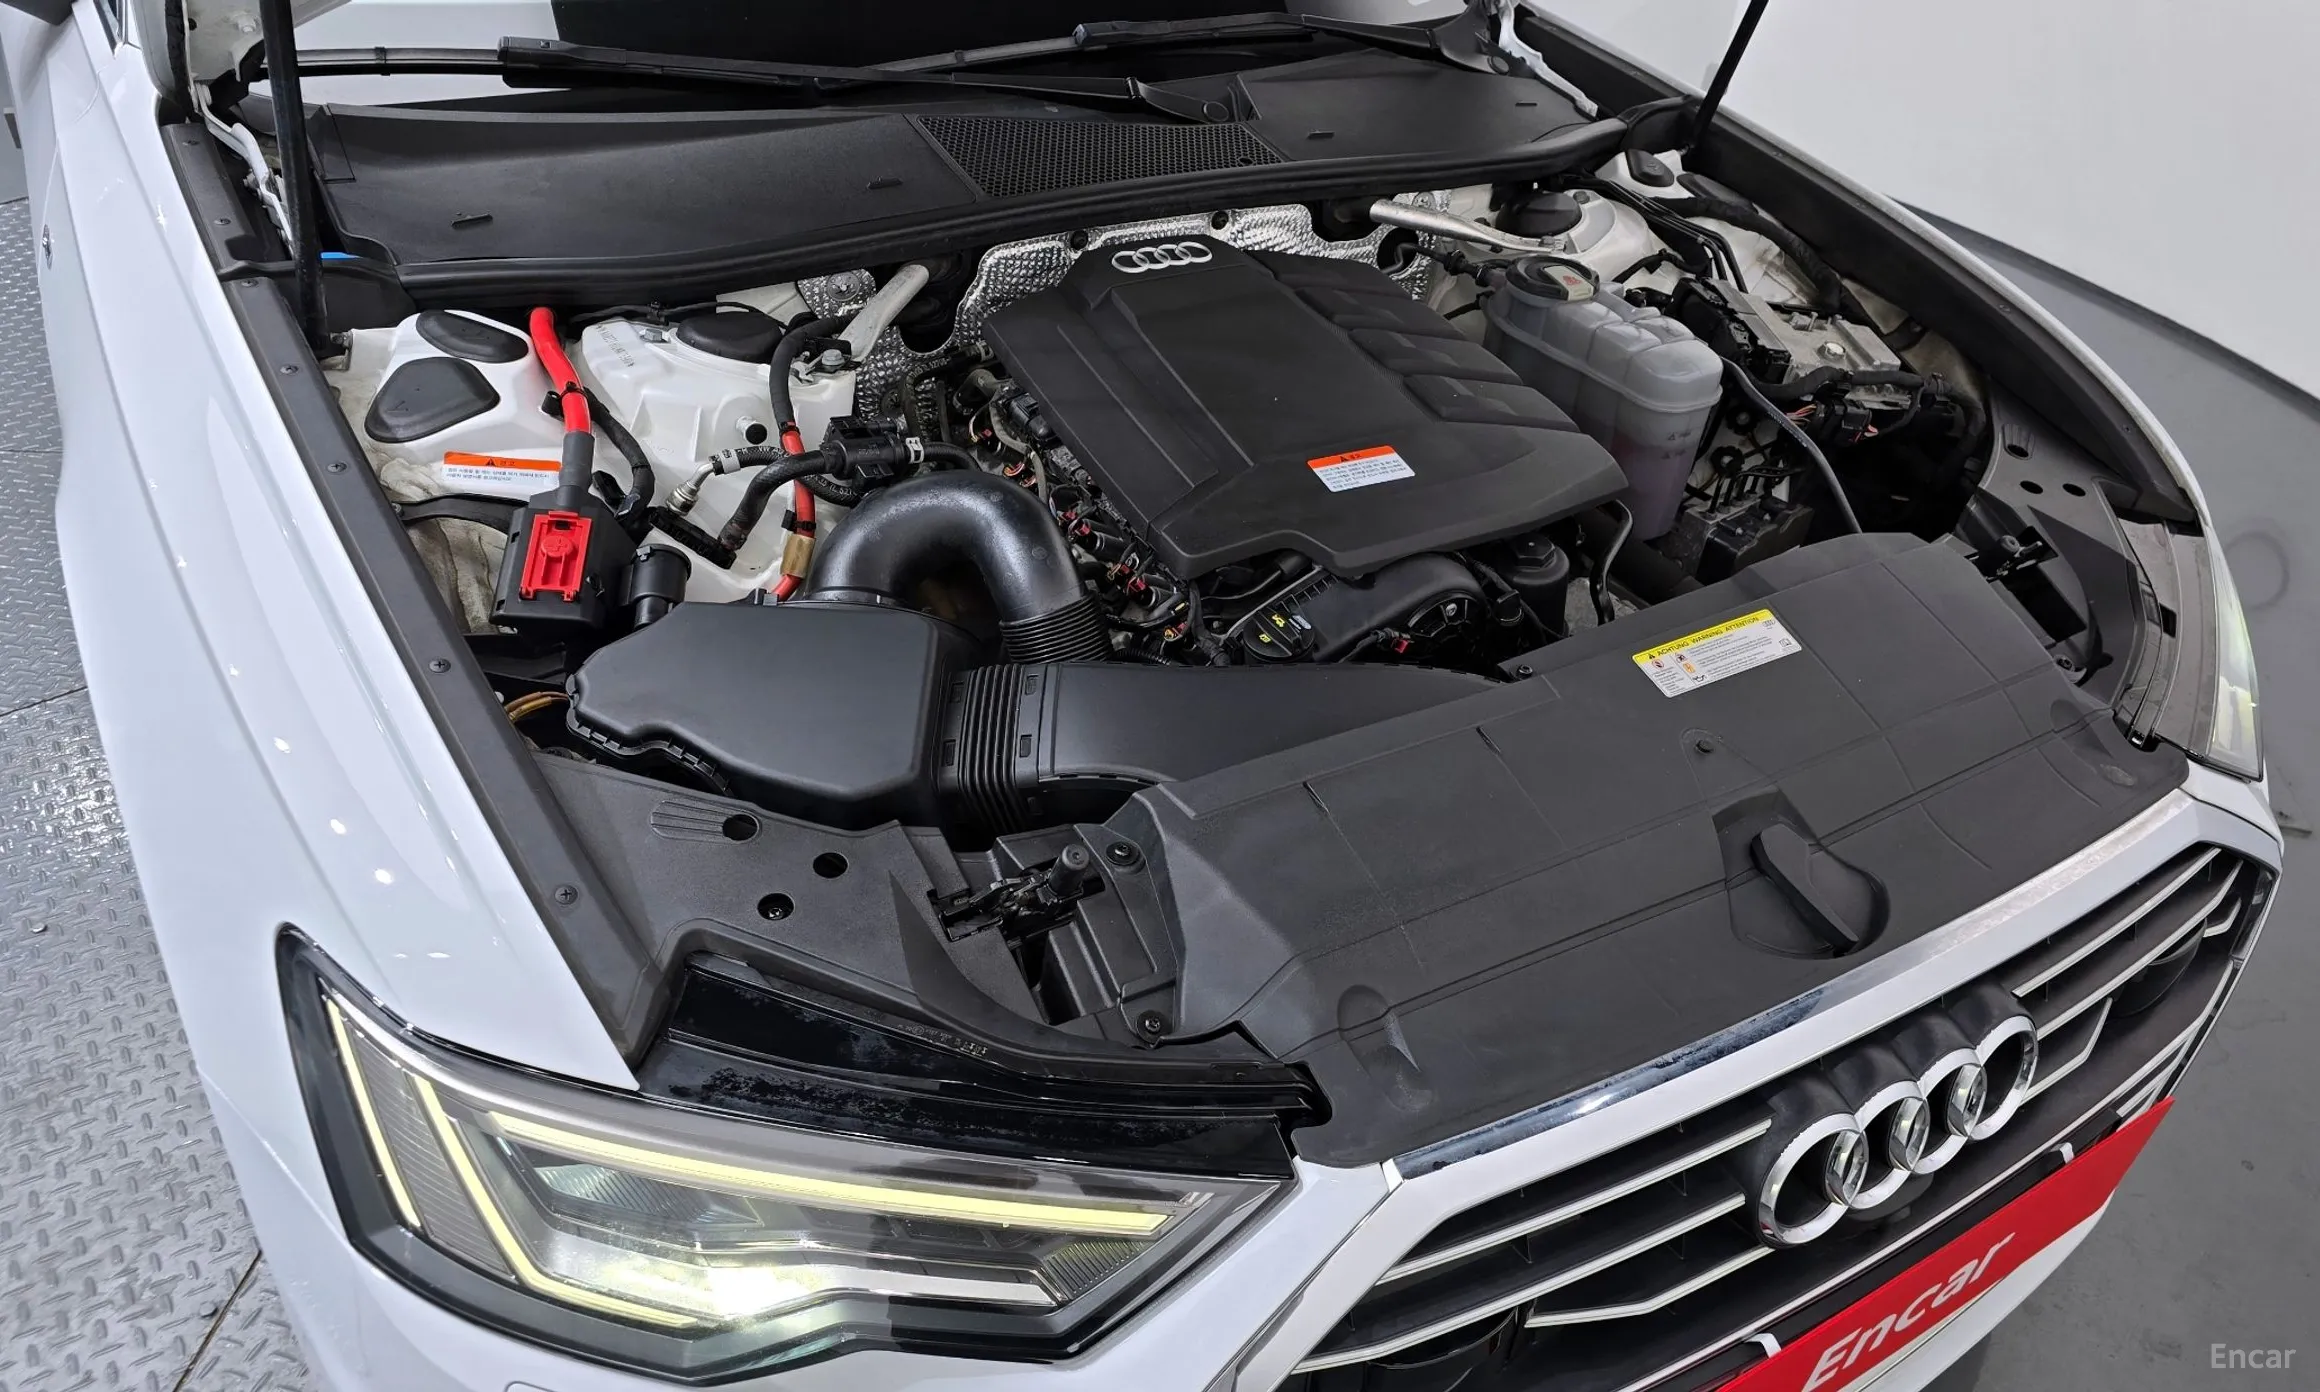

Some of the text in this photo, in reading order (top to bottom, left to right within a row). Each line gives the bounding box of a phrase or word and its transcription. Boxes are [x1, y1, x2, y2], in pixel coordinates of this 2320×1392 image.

[1657, 616, 1760, 656] ACHTUNG WARNING ATTENTION
[1801, 1232, 2016, 1392] Encar
